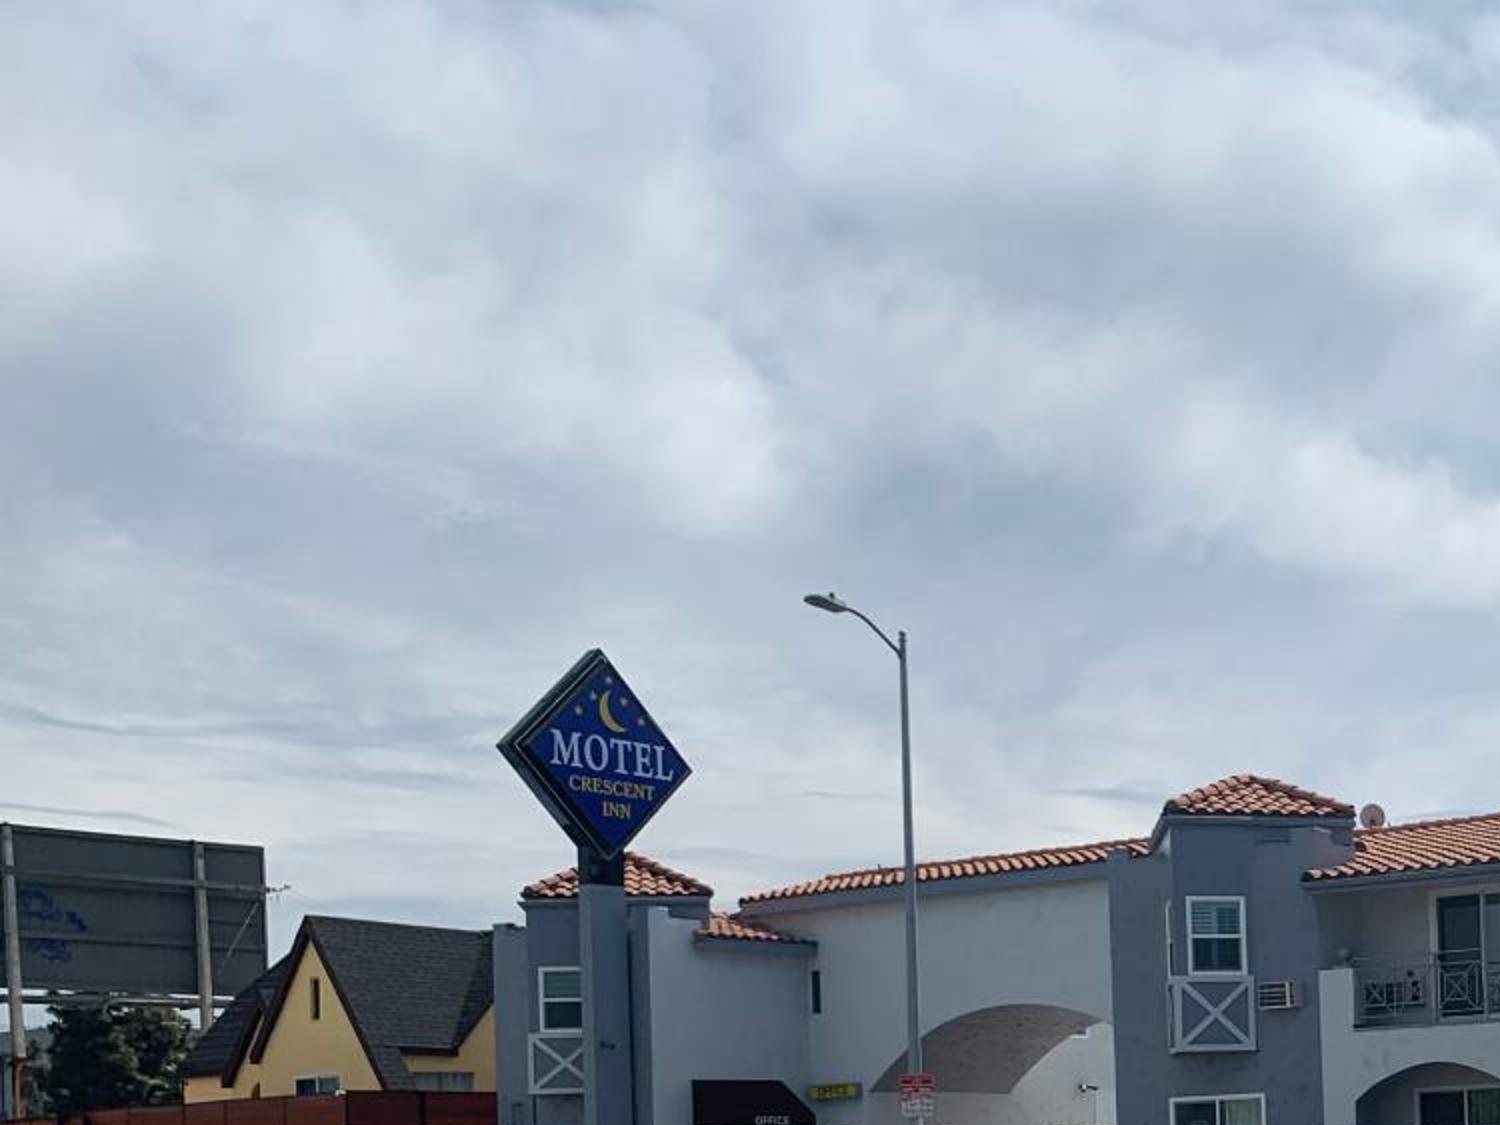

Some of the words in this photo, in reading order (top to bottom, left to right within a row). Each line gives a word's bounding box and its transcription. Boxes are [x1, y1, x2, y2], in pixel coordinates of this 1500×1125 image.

[551, 729, 673, 781] MOTEL
[569, 775, 655, 801] CRESCENT
[603, 801, 632, 819] INN
[755, 1115, 790, 1125] OFFICE
